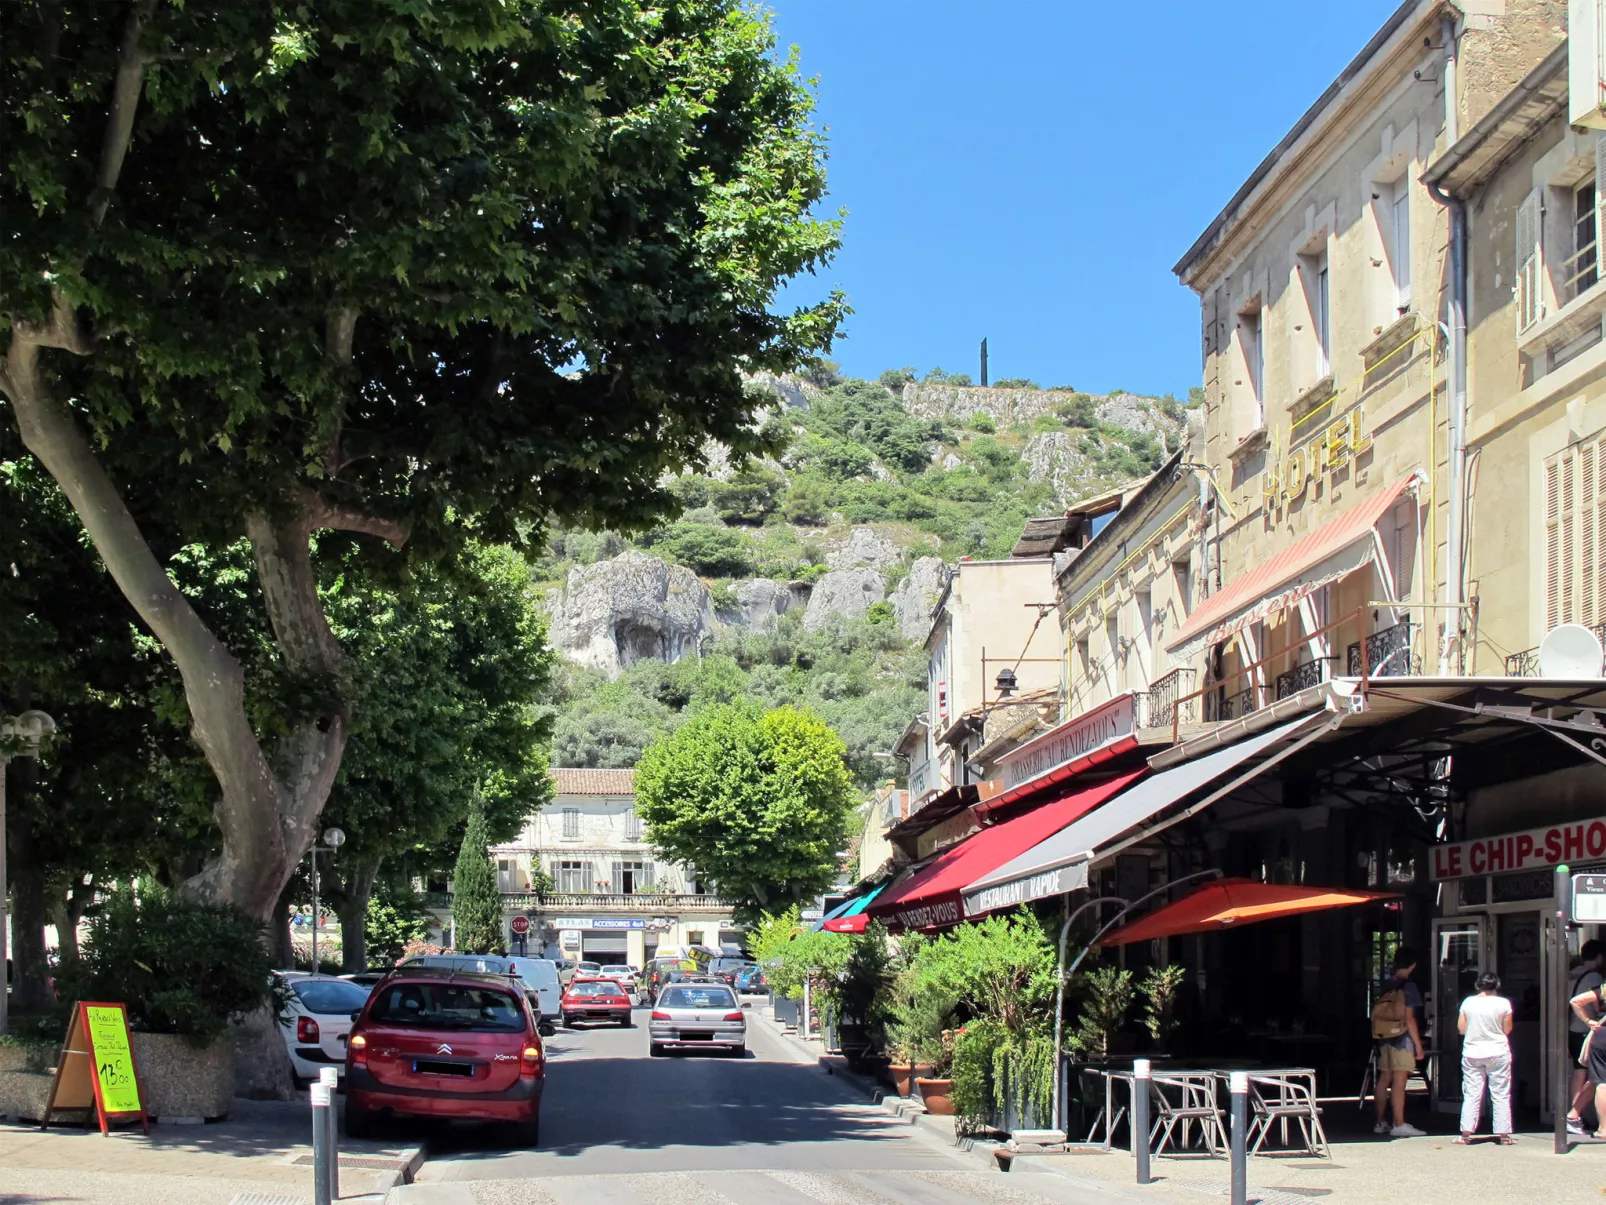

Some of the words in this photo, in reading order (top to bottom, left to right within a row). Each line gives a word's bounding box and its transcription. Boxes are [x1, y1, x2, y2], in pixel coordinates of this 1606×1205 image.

[1262, 404, 1373, 518] HOTEL
[1435, 845, 1462, 879] LE
[1469, 821, 1606, 873] CHIP-SHO
[980, 882, 1024, 910] RESTAURANT
[1029, 869, 1061, 898] RAPIDE
[594, 920, 630, 928] ACCESSOIRES
